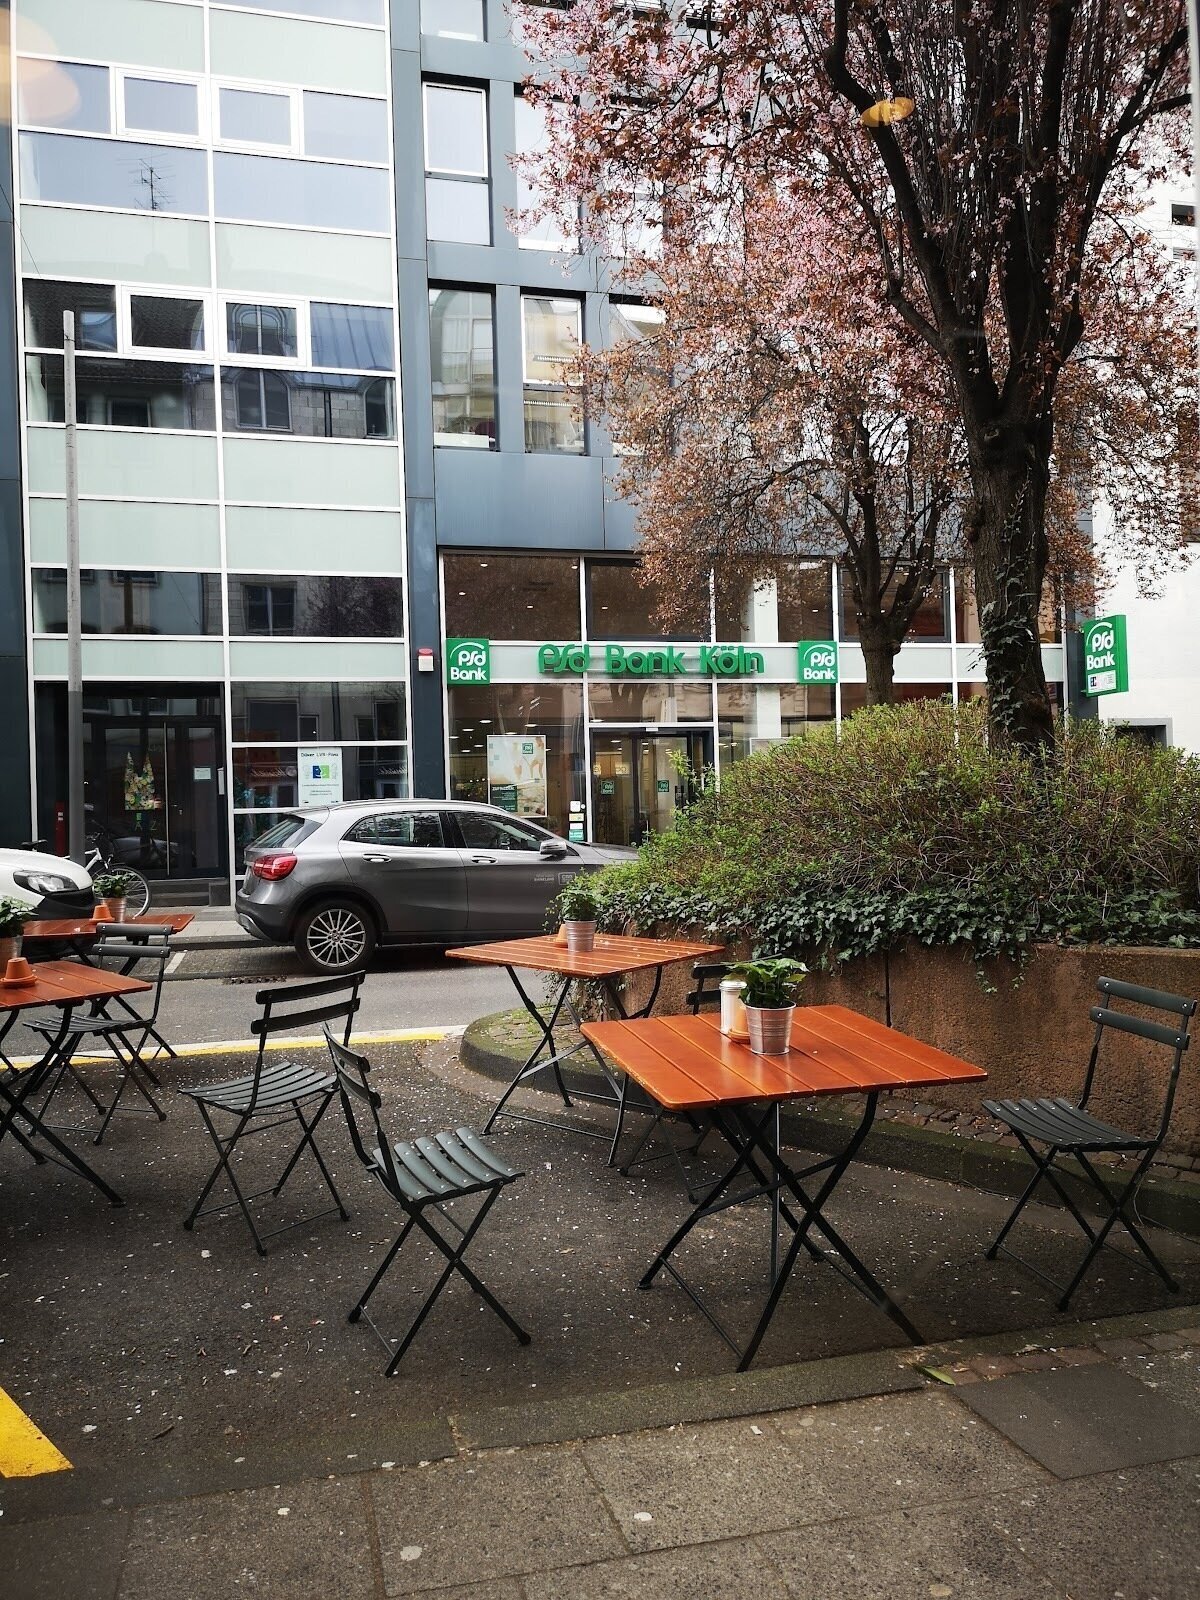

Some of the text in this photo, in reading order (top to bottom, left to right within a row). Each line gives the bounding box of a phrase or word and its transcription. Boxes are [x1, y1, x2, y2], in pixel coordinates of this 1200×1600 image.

[605, 644, 687, 674] Bank
[700, 645, 765, 674] Köln
[1087, 651, 1115, 670] Bank
[450, 667, 486, 680] Bank
[803, 668, 836, 680] Bank
